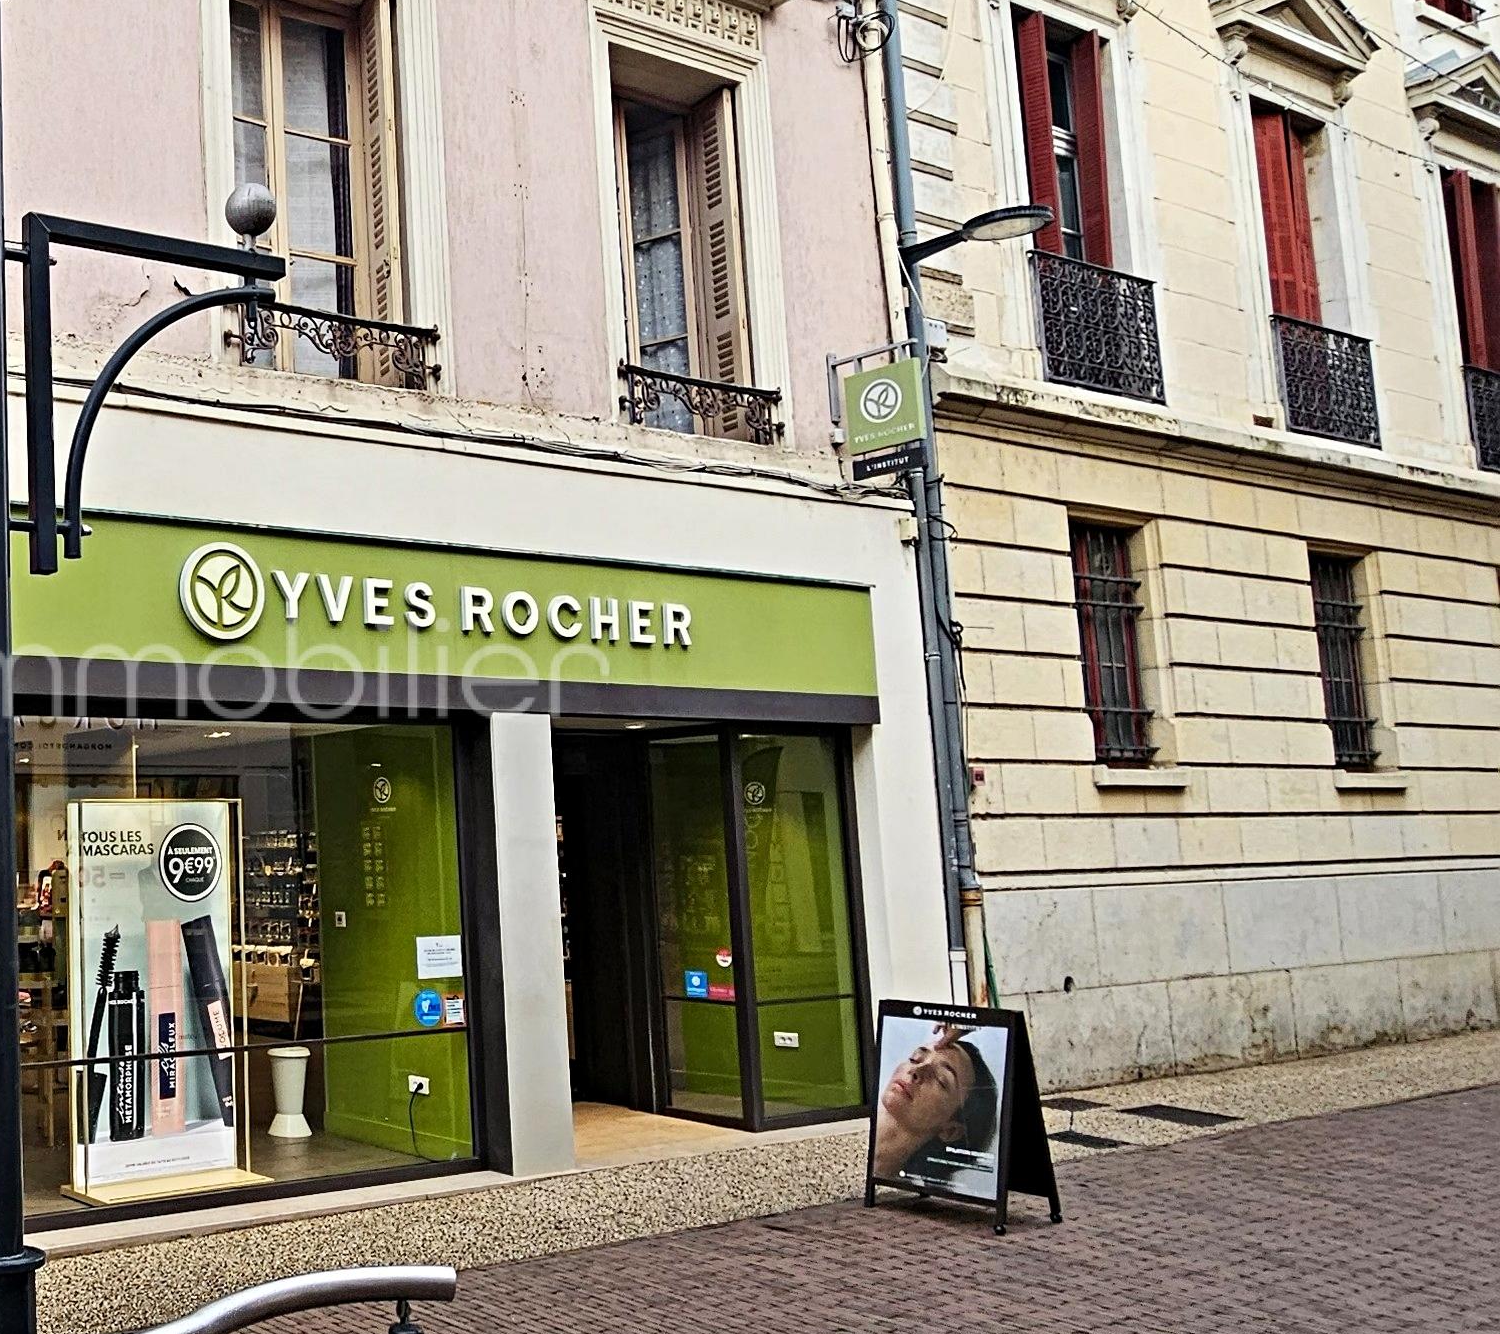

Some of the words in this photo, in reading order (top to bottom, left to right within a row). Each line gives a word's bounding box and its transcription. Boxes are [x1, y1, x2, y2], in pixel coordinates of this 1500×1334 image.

[854, 434, 876, 444] YVES
[866, 455, 910, 472] L'INSTITUT
[271, 568, 437, 629] YVES
[459, 584, 693, 648] ROCHER
[82, 830, 117, 843] TOUS
[120, 830, 142, 843] LES
[80, 843, 155, 856] MASCARAS
[174, 846, 213, 855] SEULEMENT
[923, 1008, 943, 1016] YVES
[944, 1010, 977, 1019] ROCHER
